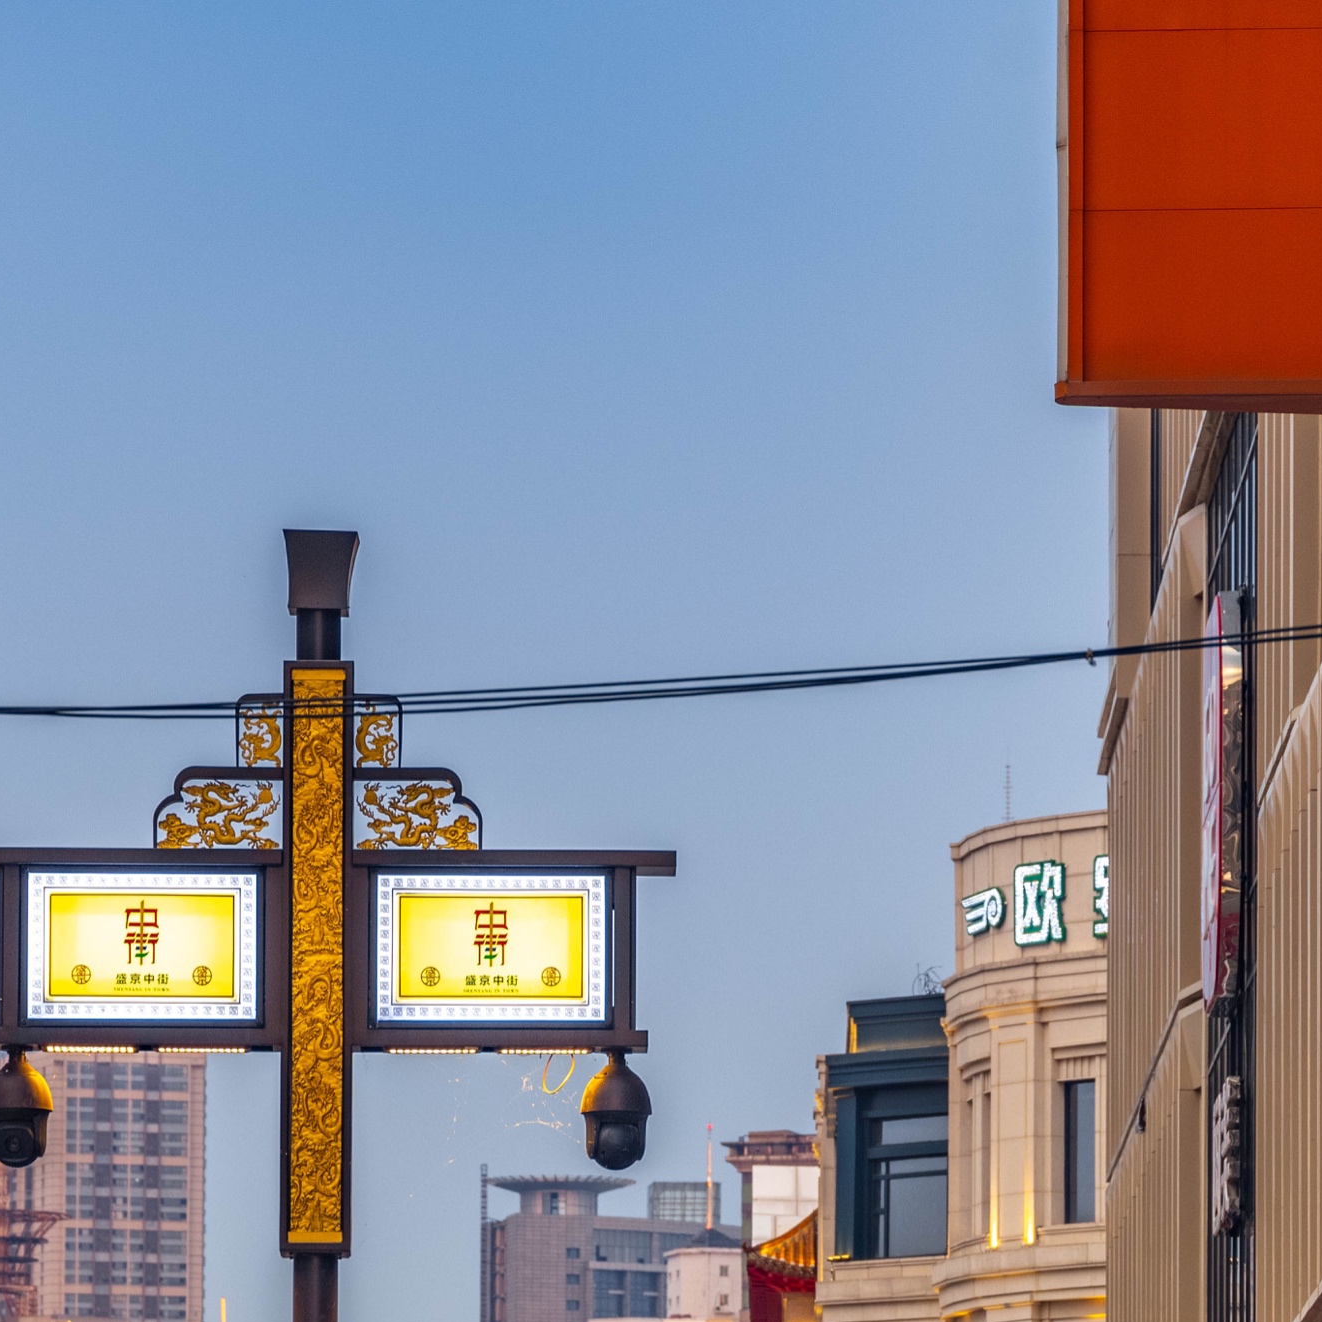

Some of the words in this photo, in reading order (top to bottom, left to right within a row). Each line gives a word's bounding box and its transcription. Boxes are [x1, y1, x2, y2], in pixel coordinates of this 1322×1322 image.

[116, 973, 169, 985] 盛京中街
[465, 974, 518, 986] 盛京中街
